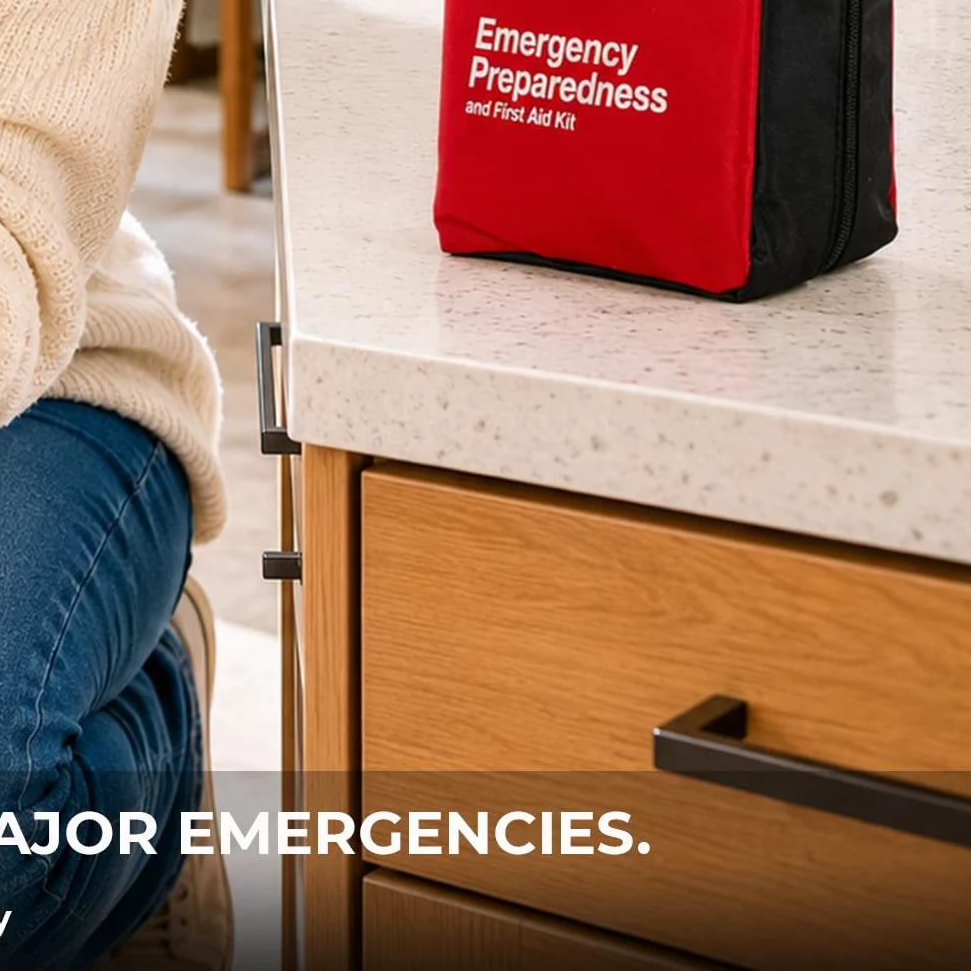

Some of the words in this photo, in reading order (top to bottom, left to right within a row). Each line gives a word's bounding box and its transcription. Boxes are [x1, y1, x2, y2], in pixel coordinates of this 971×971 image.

[475, 16, 639, 77] Emergency
[468, 55, 668, 114] Preparedness
[465, 100, 492, 117] and
[492, 102, 525, 124] First
[526, 106, 553, 127] Aid
[554, 110, 577, 131] Kit
